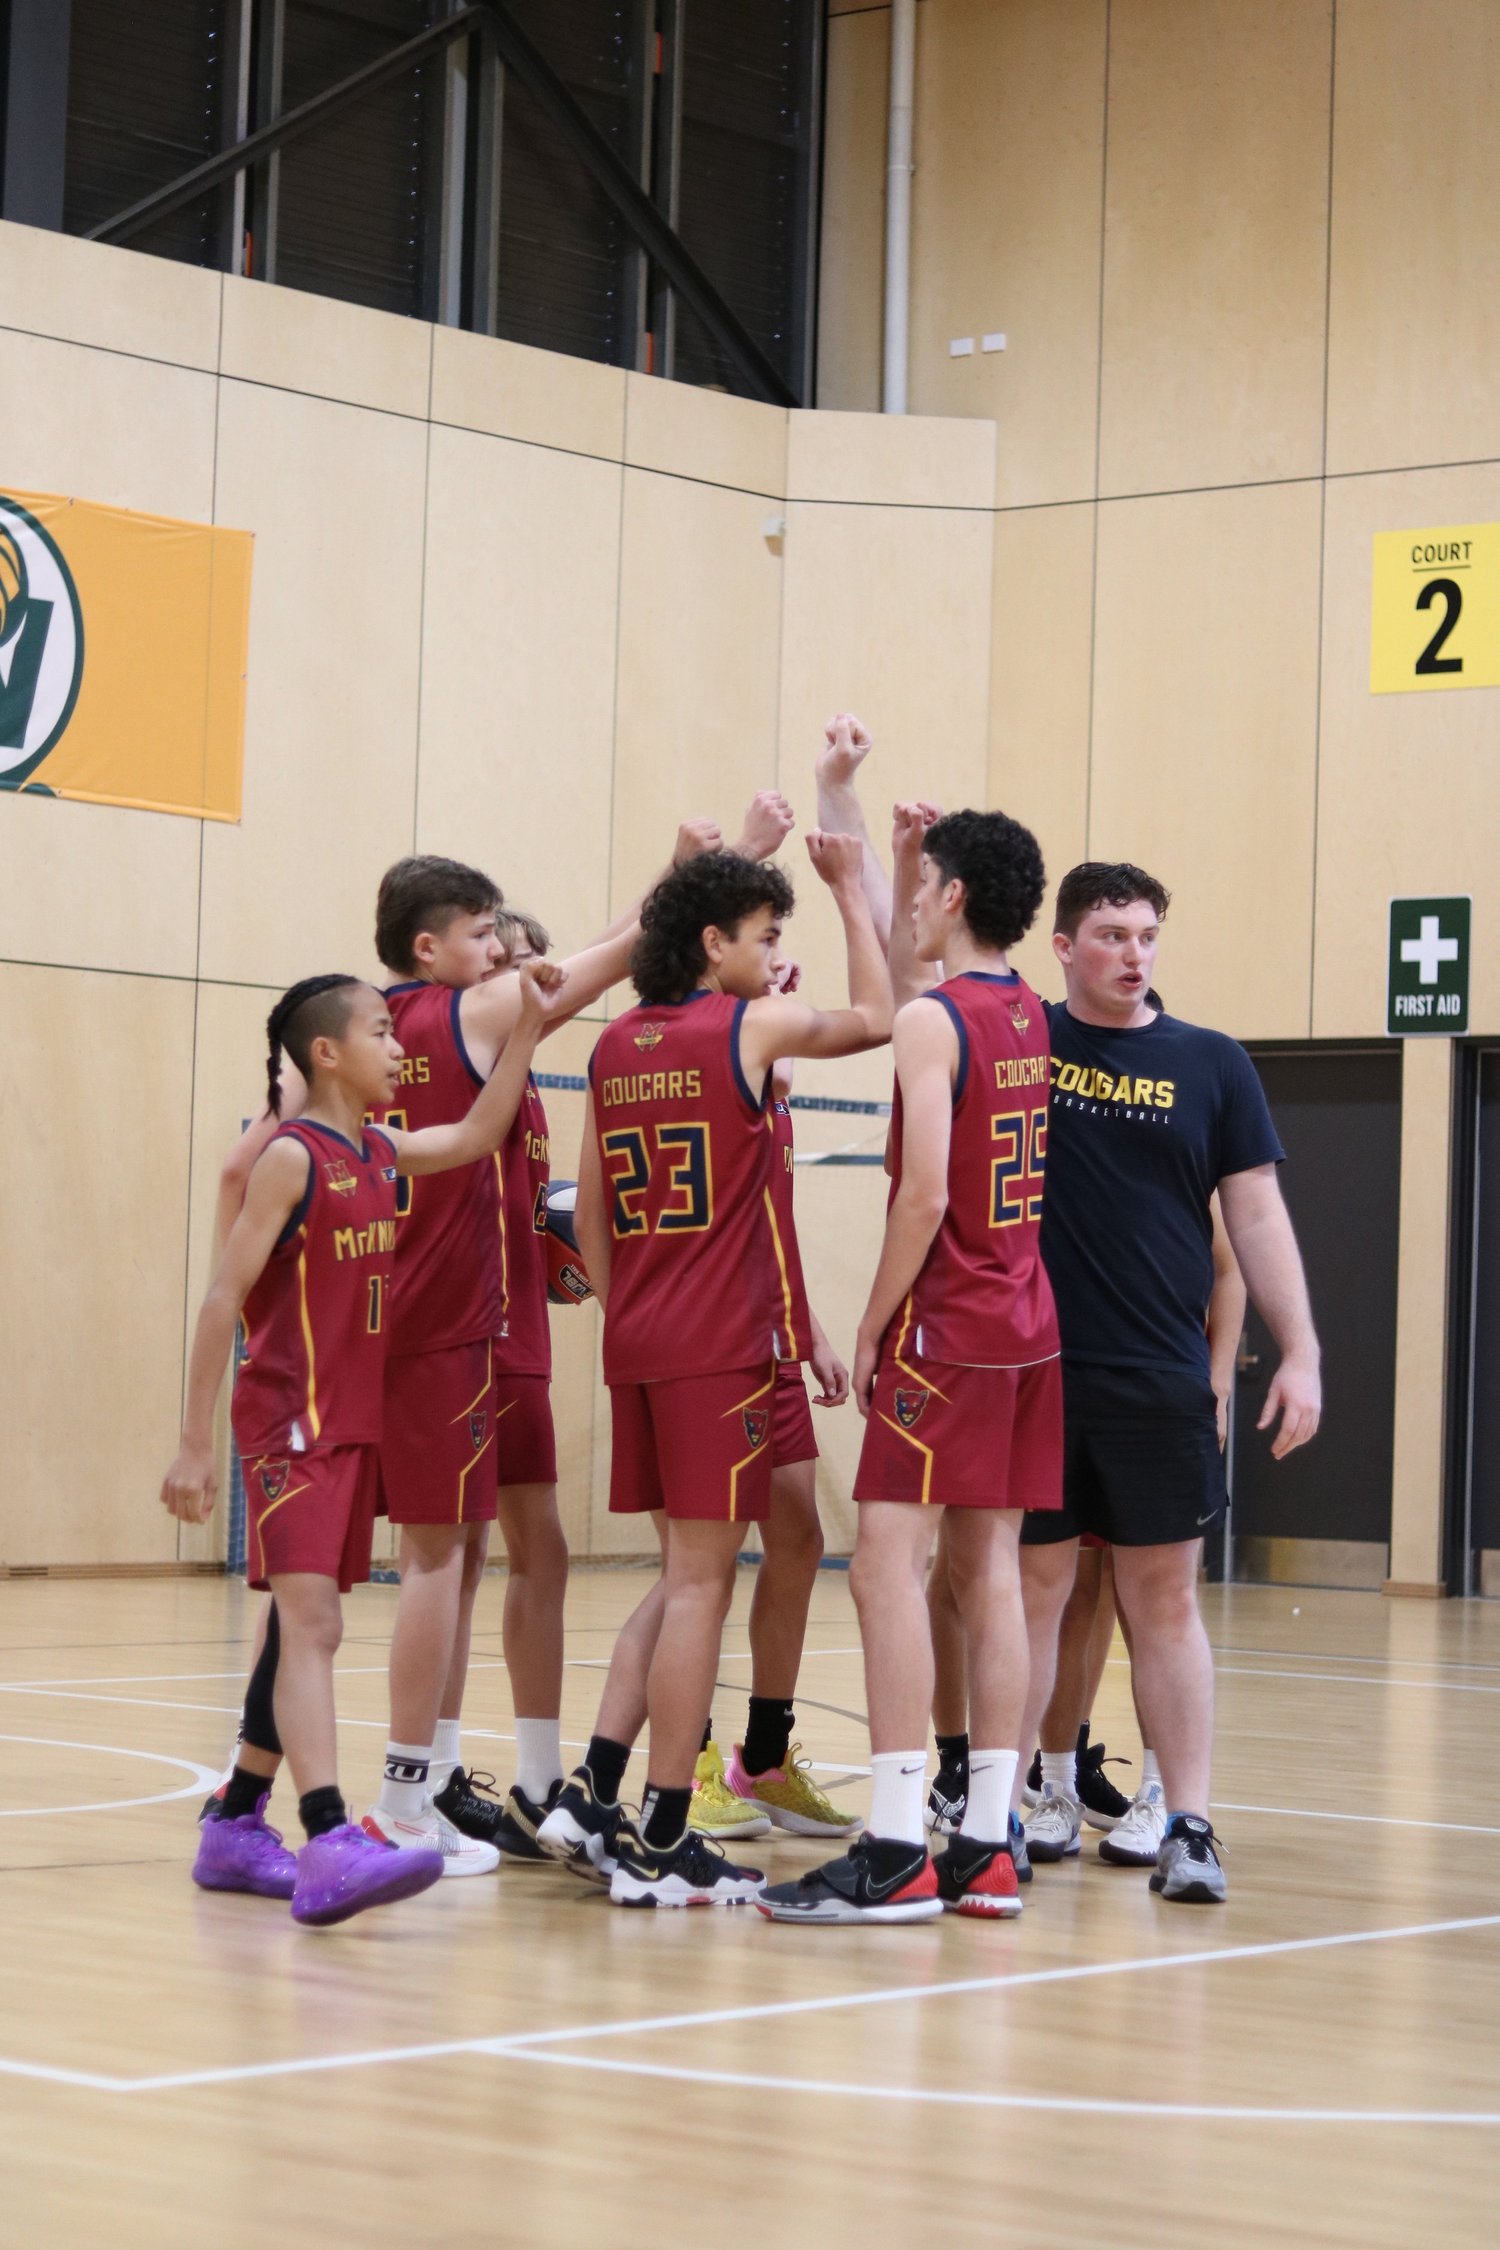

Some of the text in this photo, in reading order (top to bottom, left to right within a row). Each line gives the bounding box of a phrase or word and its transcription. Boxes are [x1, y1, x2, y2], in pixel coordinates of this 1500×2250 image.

[1411, 541, 1472, 563] COURT
[1415, 578, 1463, 675] 2
[1395, 994, 1461, 1017] FIRST AID
[994, 1056, 1047, 1089] COUGAR
[1050, 1056, 1175, 1109] COUGARS
[1053, 1095, 1169, 1124] BASKETBALL
[602, 1122, 713, 1240] 23
